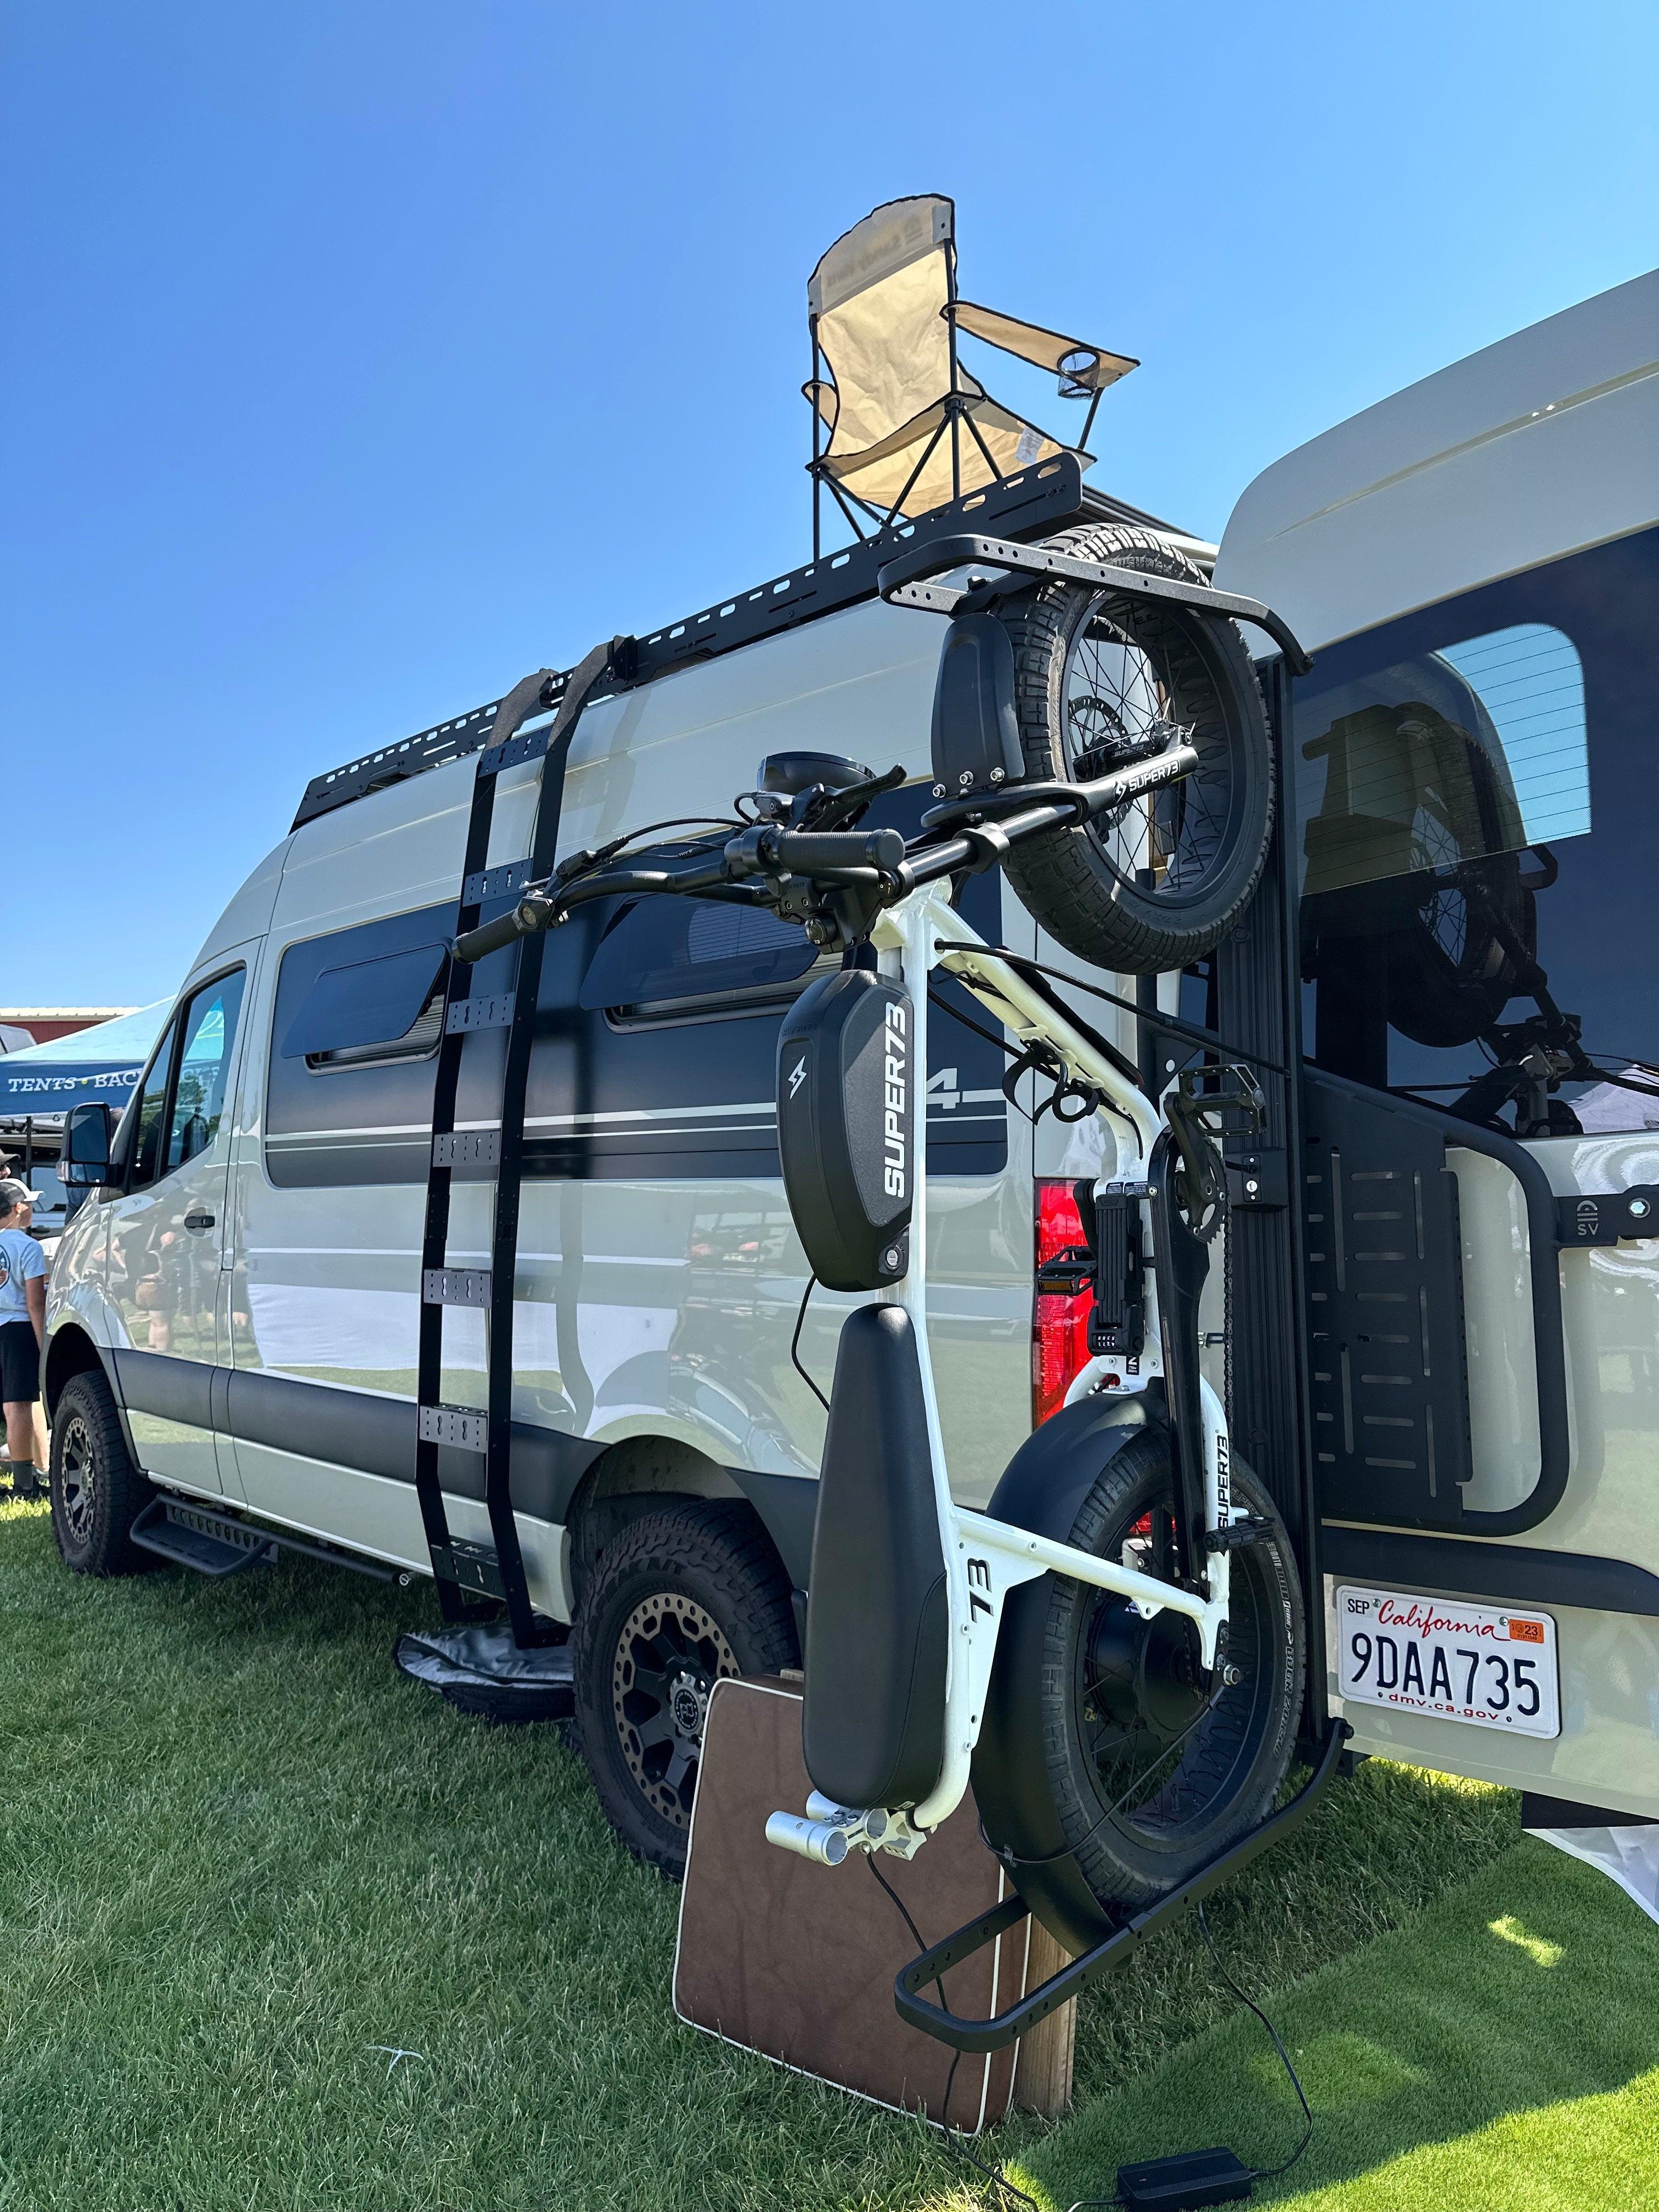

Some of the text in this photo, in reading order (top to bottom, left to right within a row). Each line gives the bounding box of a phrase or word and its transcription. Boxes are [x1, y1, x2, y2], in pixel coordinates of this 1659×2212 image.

[1128, 760, 1179, 792] SUPER73
[8, 1071, 142, 1092] TENTS BAC
[884, 1001, 906, 1198] SUPER73
[1577, 1223, 1599, 1235] SV
[1217, 1434, 1229, 1529] SUPER73
[967, 1558, 994, 1624] 73
[1347, 1598, 1370, 1615] SEP
[1378, 1600, 1511, 1641] California
[1525, 1624, 1538, 1636] 23
[1351, 1633, 1540, 1716] 9DAA735
[1389, 1694, 1499, 1720] dmv.ca.gov
